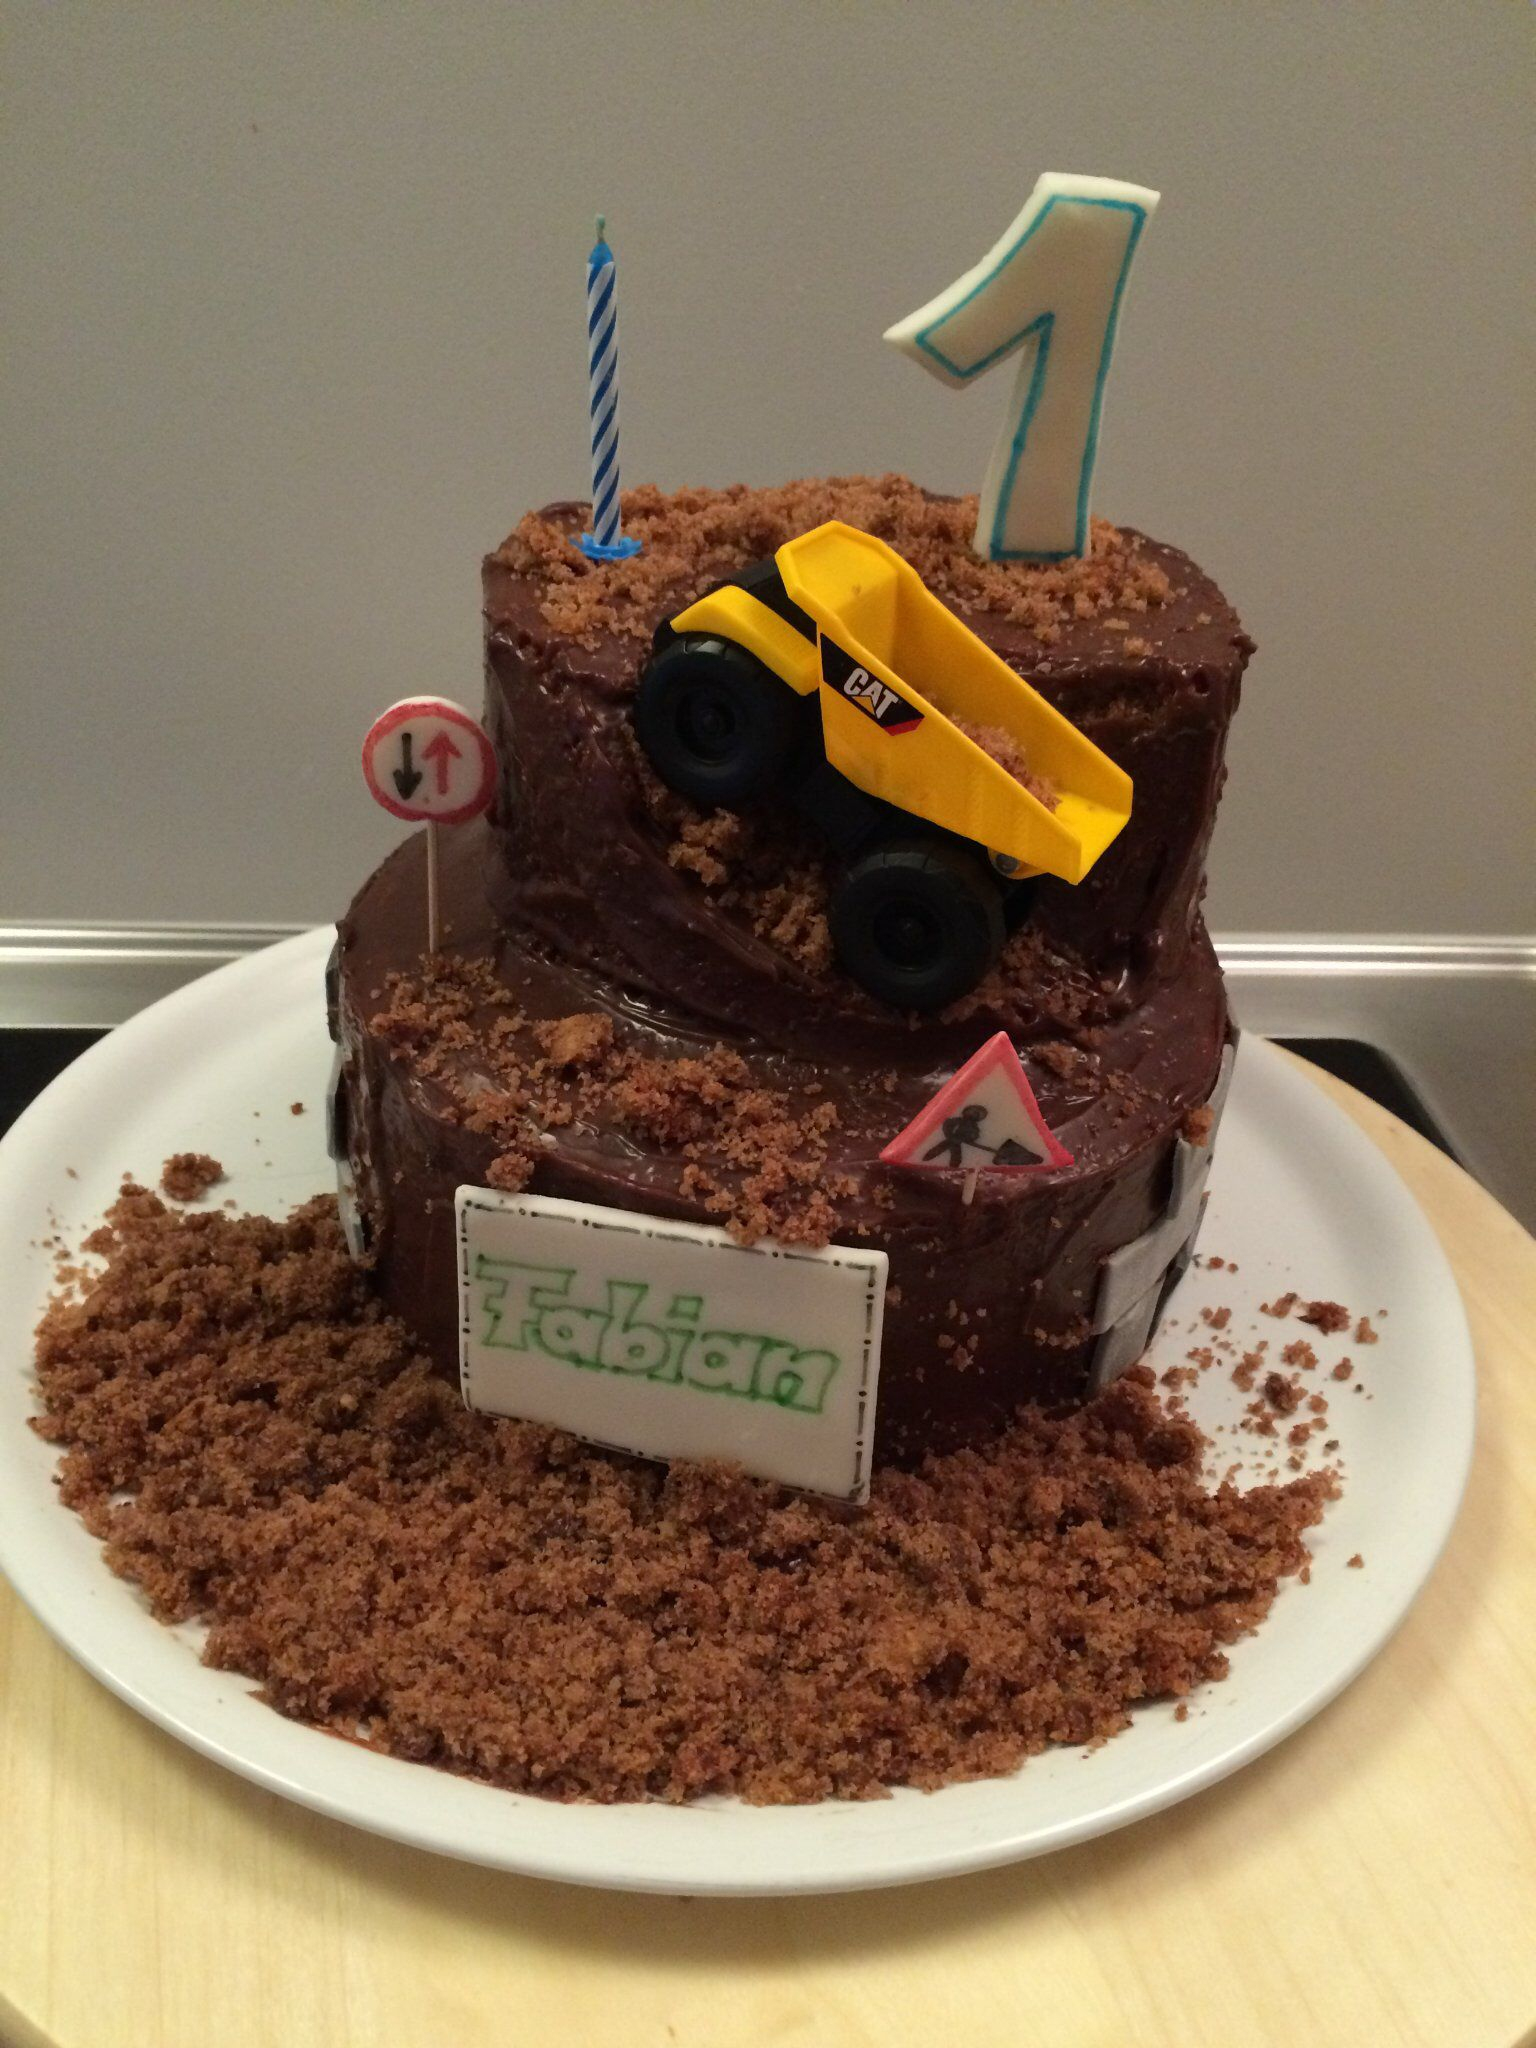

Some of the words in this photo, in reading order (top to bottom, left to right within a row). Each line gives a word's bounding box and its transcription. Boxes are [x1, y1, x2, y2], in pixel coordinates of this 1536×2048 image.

[883, 172, 1161, 561] 1
[843, 667, 899, 720] CAT
[476, 1254, 840, 1415] Fabian
